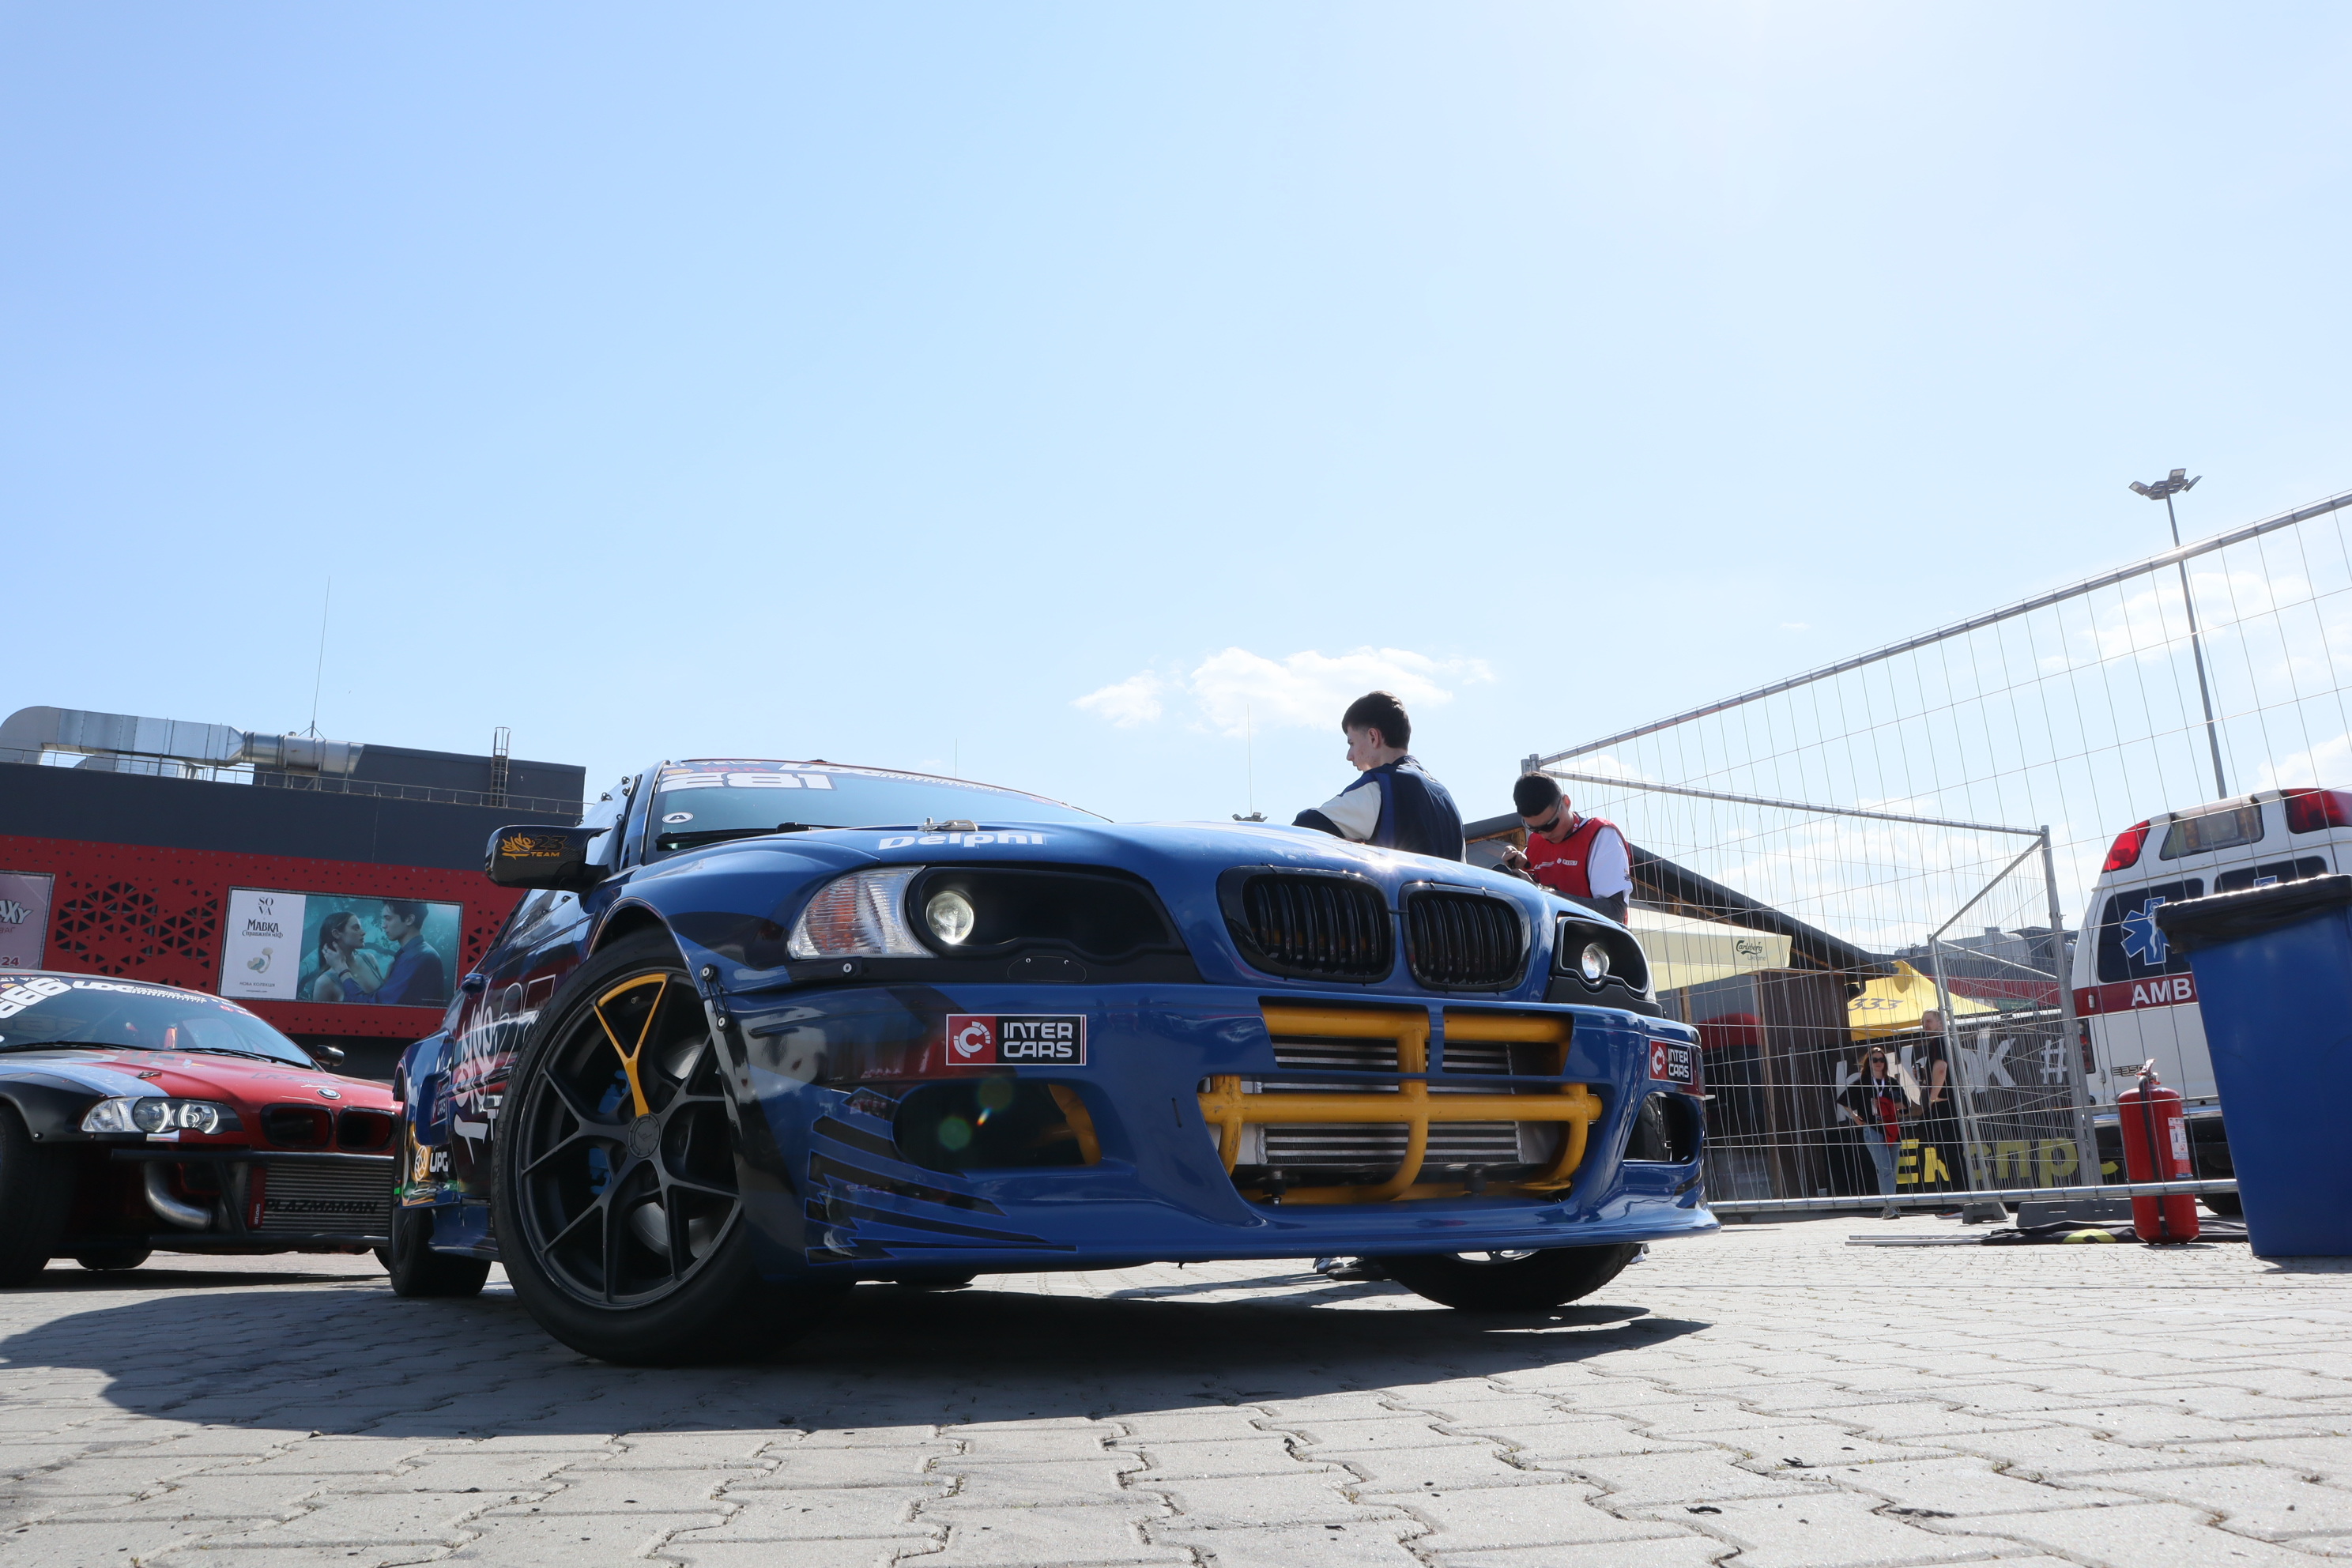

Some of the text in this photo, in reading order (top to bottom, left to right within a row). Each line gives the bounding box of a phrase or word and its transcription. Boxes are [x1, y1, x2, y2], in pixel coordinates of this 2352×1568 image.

[660, 772, 833, 792] 281
[878, 832, 1043, 850] Delphi
[1736, 940, 1762, 954] Carlsberg
[2, 957, 19, 966] 24
[2132, 978, 2194, 1007] AMB
[1848, 998, 1904, 1012] 333
[1004, 1022, 1072, 1038] INTER
[1004, 1042, 1072, 1057] CARS
[1668, 1048, 1689, 1064] INTER
[1668, 1063, 1689, 1078] CARS
[429, 1152, 448, 1173] UPG
